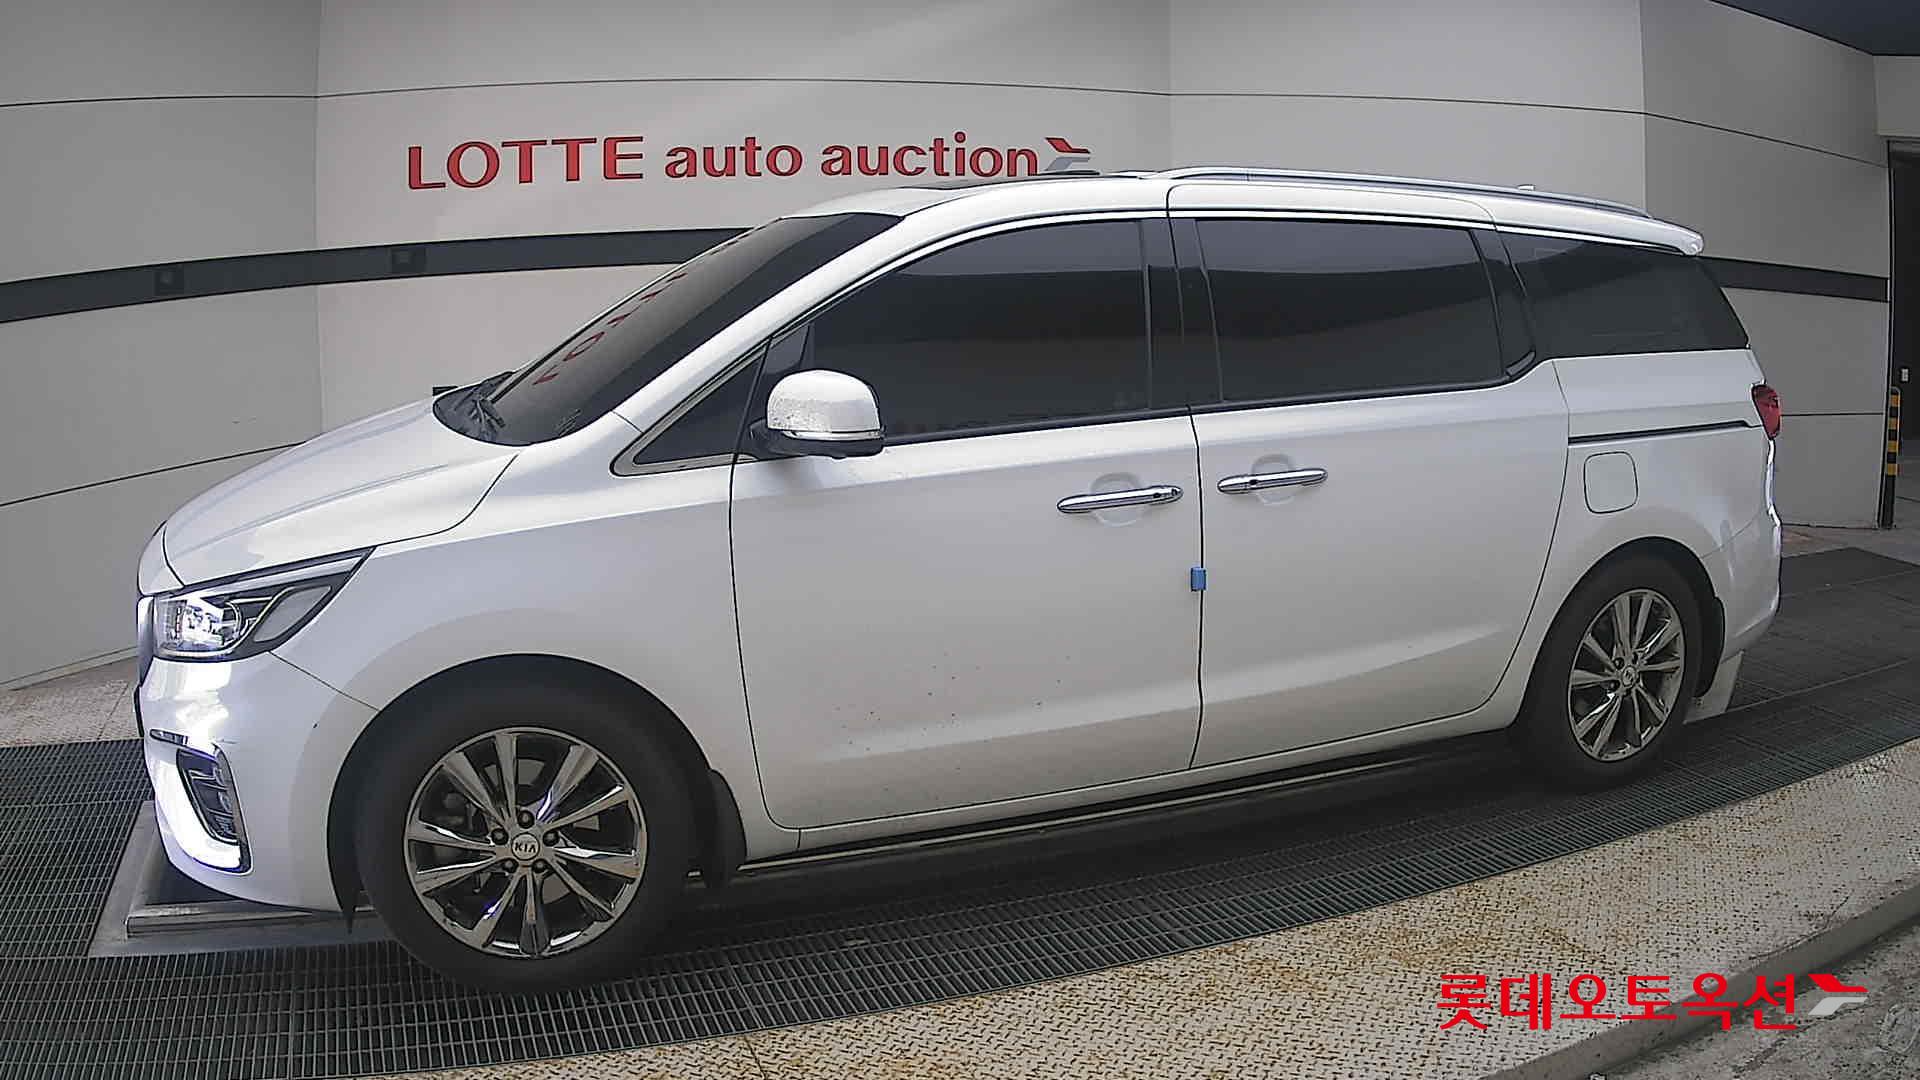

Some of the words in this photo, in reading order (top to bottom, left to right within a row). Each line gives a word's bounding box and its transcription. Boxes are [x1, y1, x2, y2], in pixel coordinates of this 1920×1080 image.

[408, 135, 644, 190] LOTTE
[664, 137, 803, 178] auto
[821, 133, 1039, 178] auction
[514, 842, 537, 853] KIA
